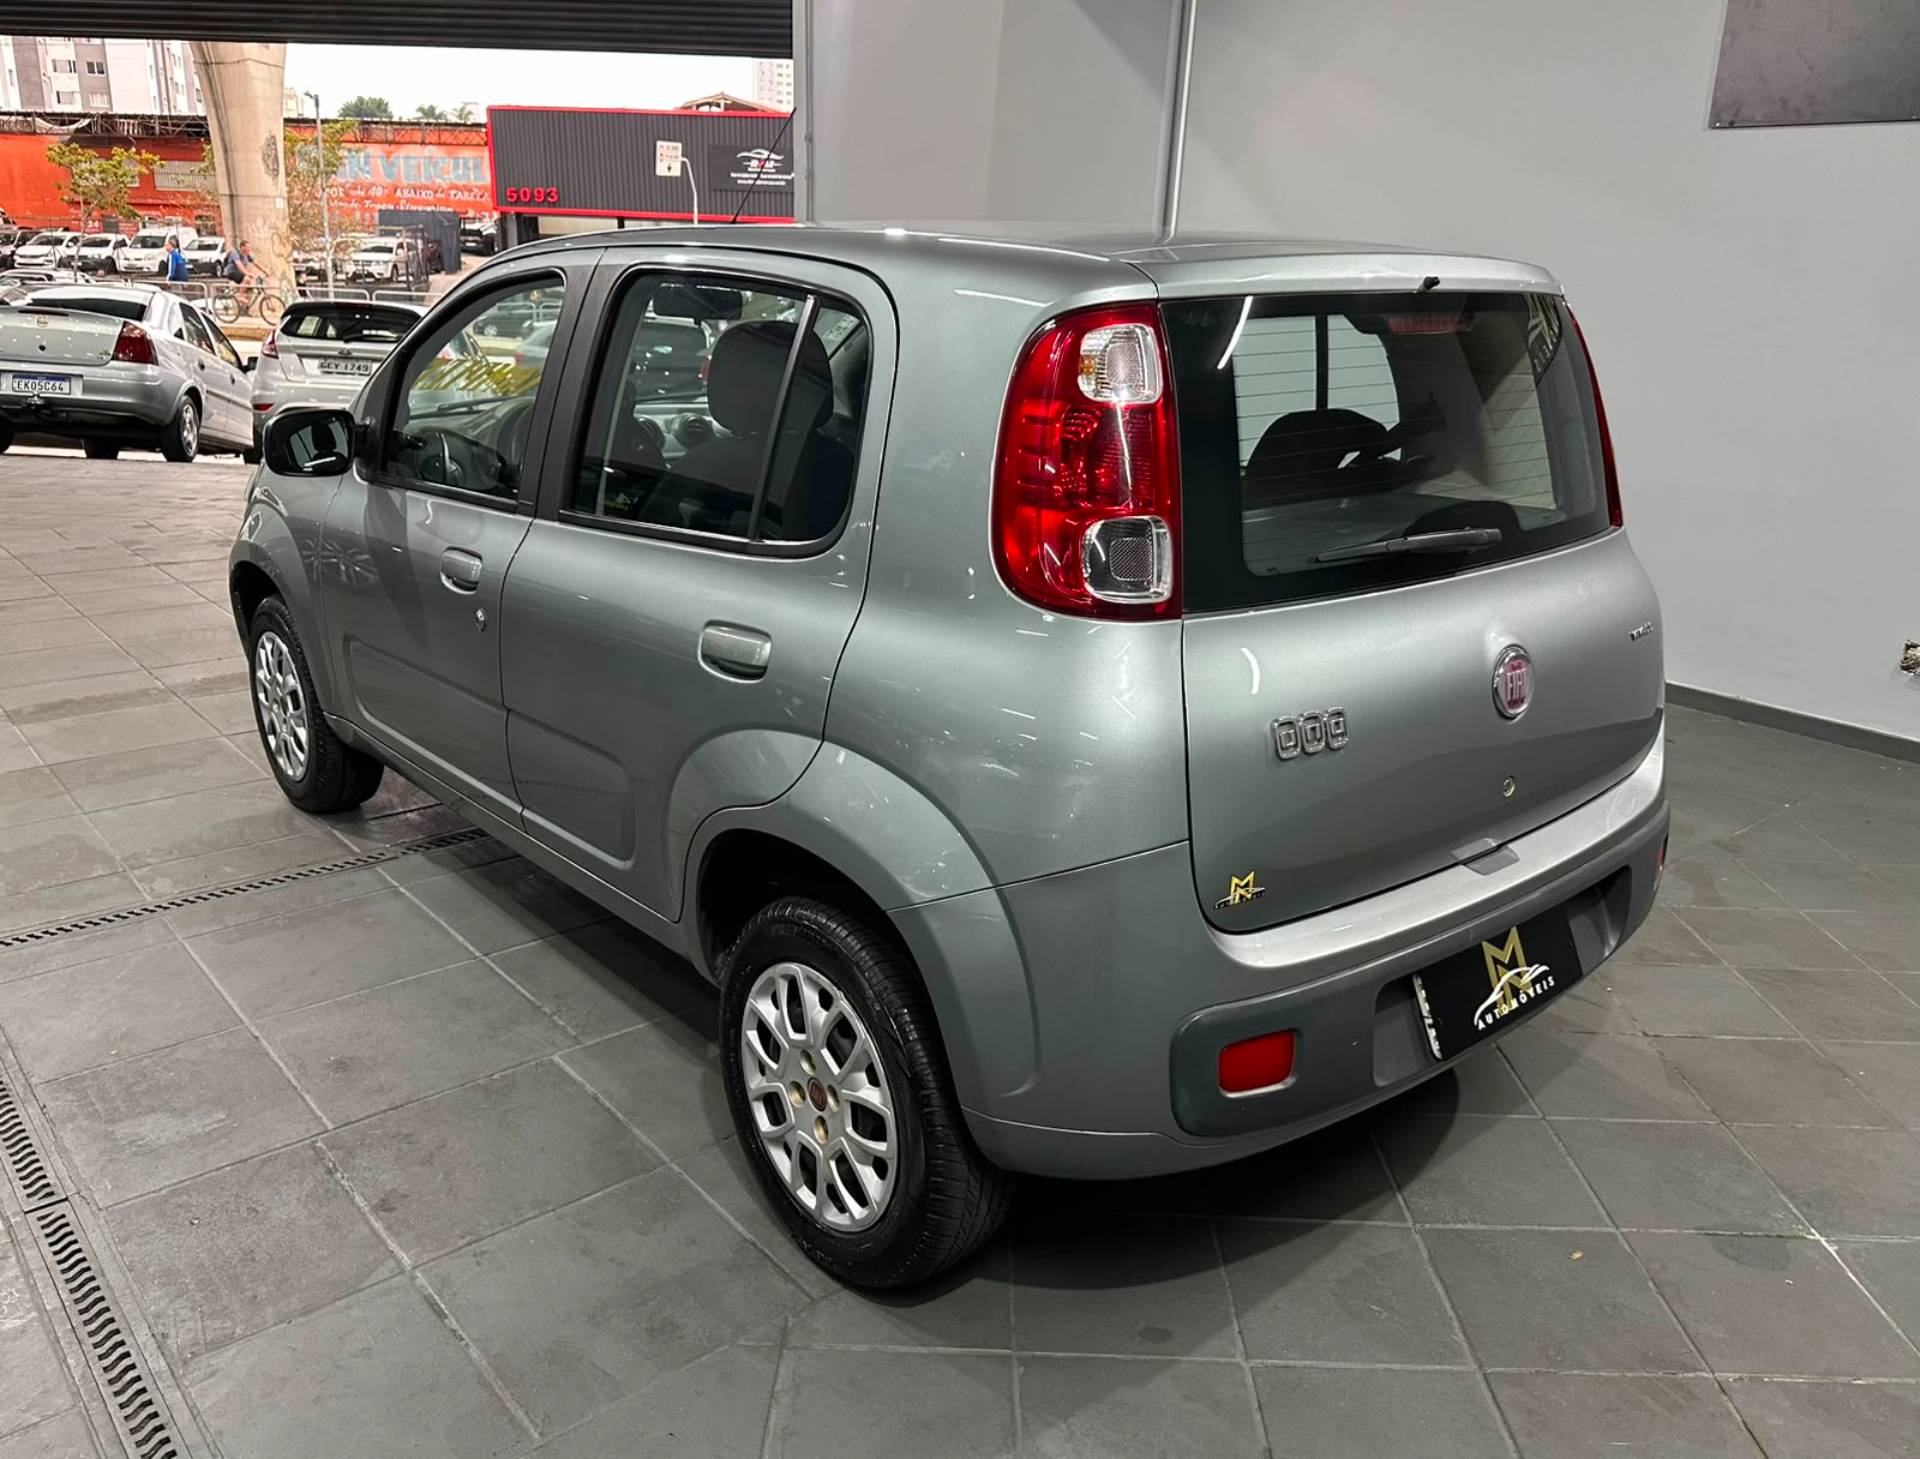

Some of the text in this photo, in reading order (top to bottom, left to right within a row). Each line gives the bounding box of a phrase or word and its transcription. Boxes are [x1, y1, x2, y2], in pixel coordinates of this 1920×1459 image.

[378, 146, 488, 183] VEÍCUL
[395, 187, 434, 200] ABAIXO
[506, 186, 559, 203] 5093
[1506, 668, 1529, 701] FIAT
[1477, 975, 1556, 1031] AUTOMÓVEIS
